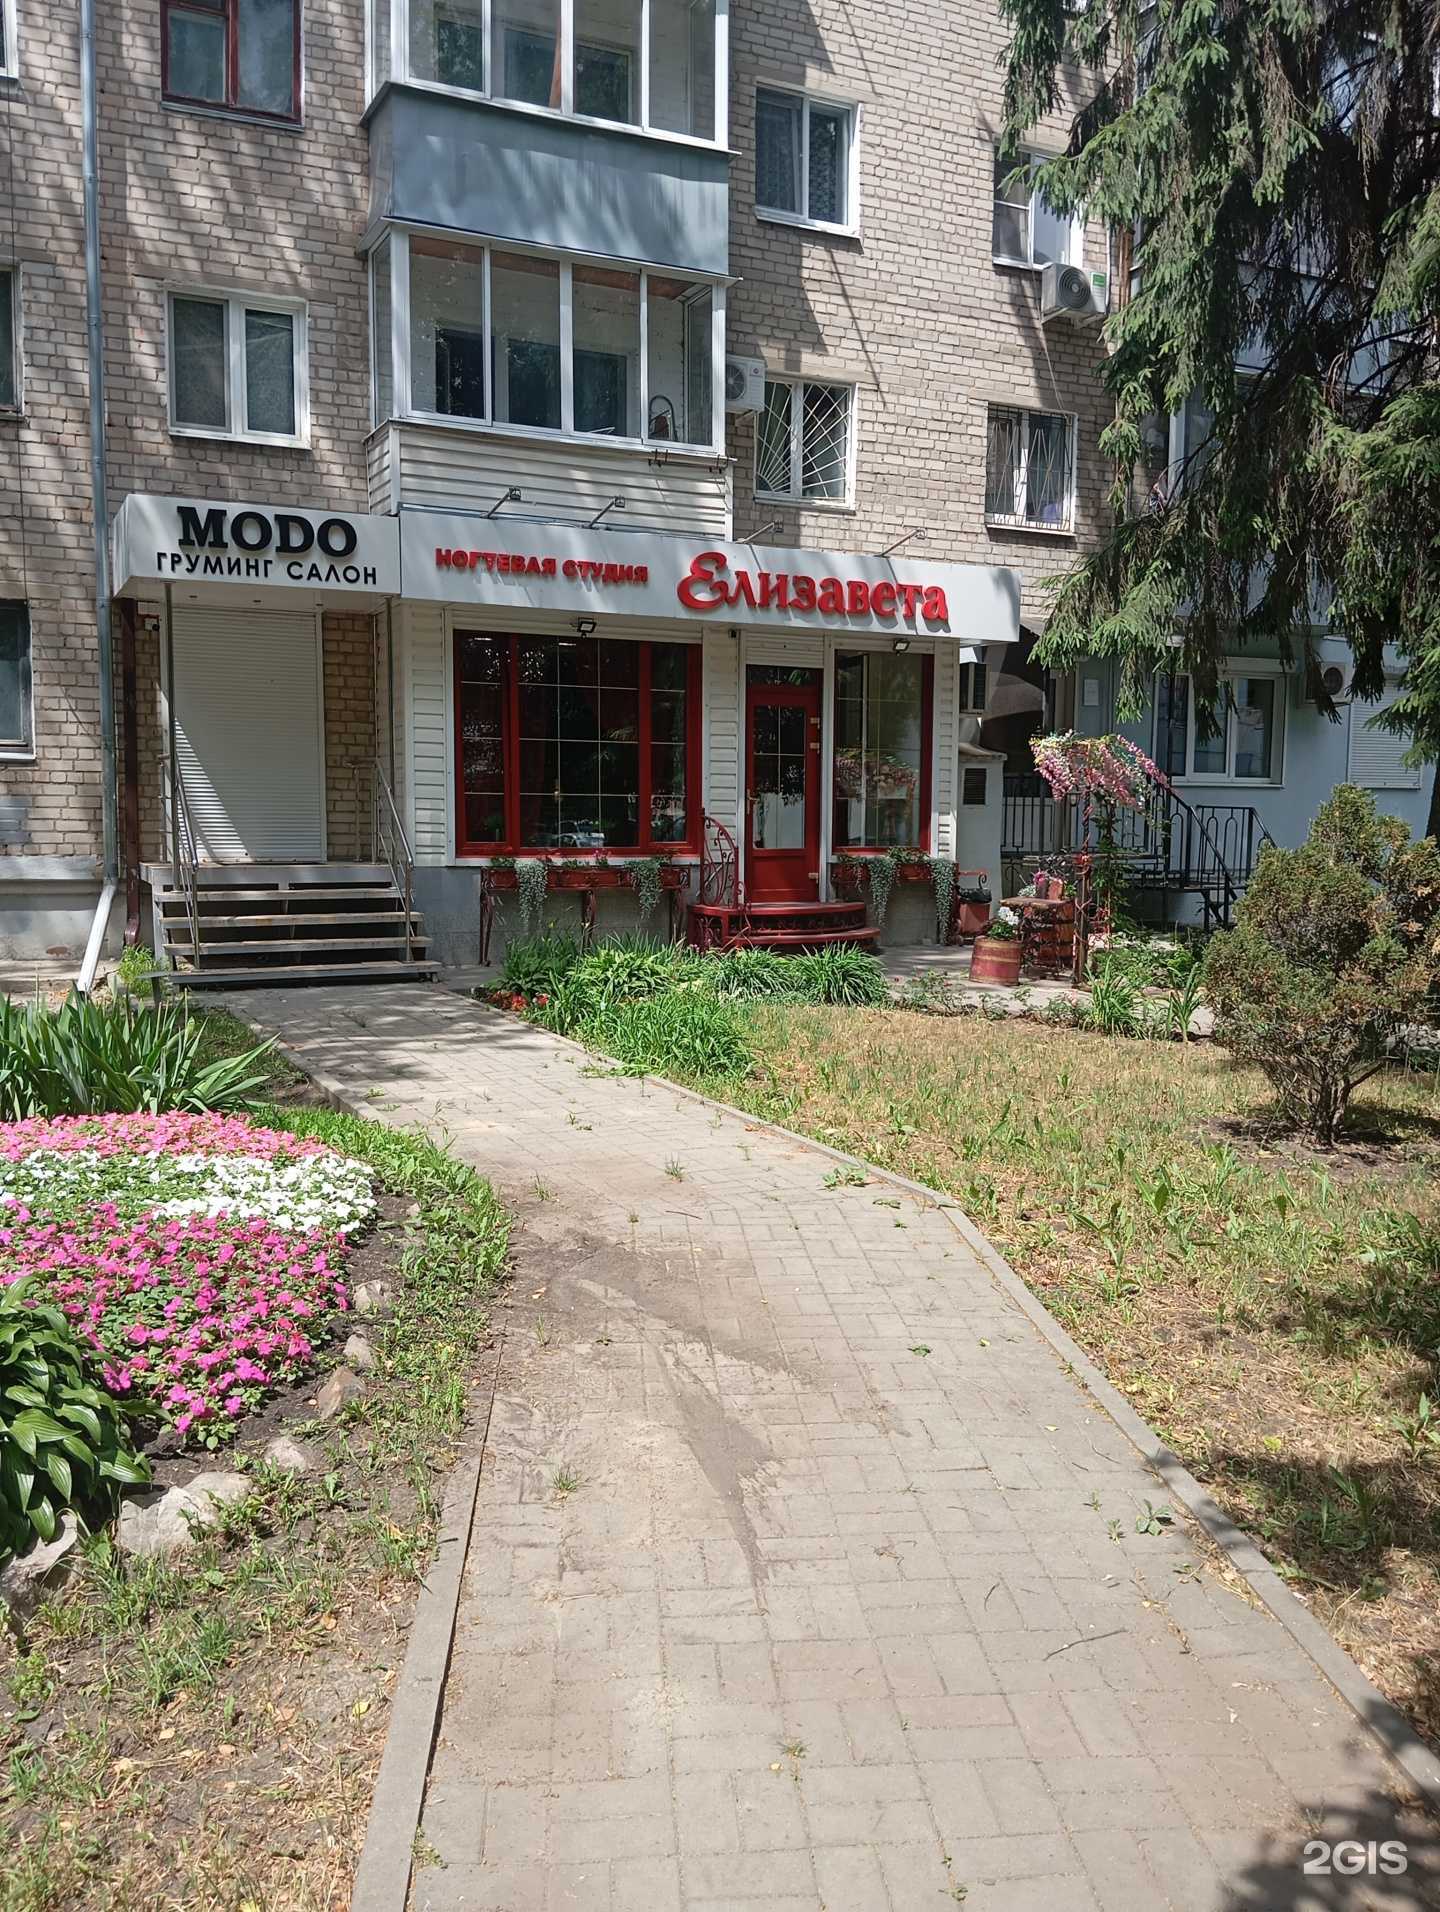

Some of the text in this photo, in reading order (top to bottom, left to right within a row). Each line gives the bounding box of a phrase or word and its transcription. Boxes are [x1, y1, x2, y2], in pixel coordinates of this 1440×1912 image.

[177, 506, 358, 558] MODO
[156, 552, 377, 585] ГРУМИНГ САЛОН
[435, 548, 648, 584] НОГТЕВАЯ СТУДИЯ
[676, 551, 949, 621] Елизавета
